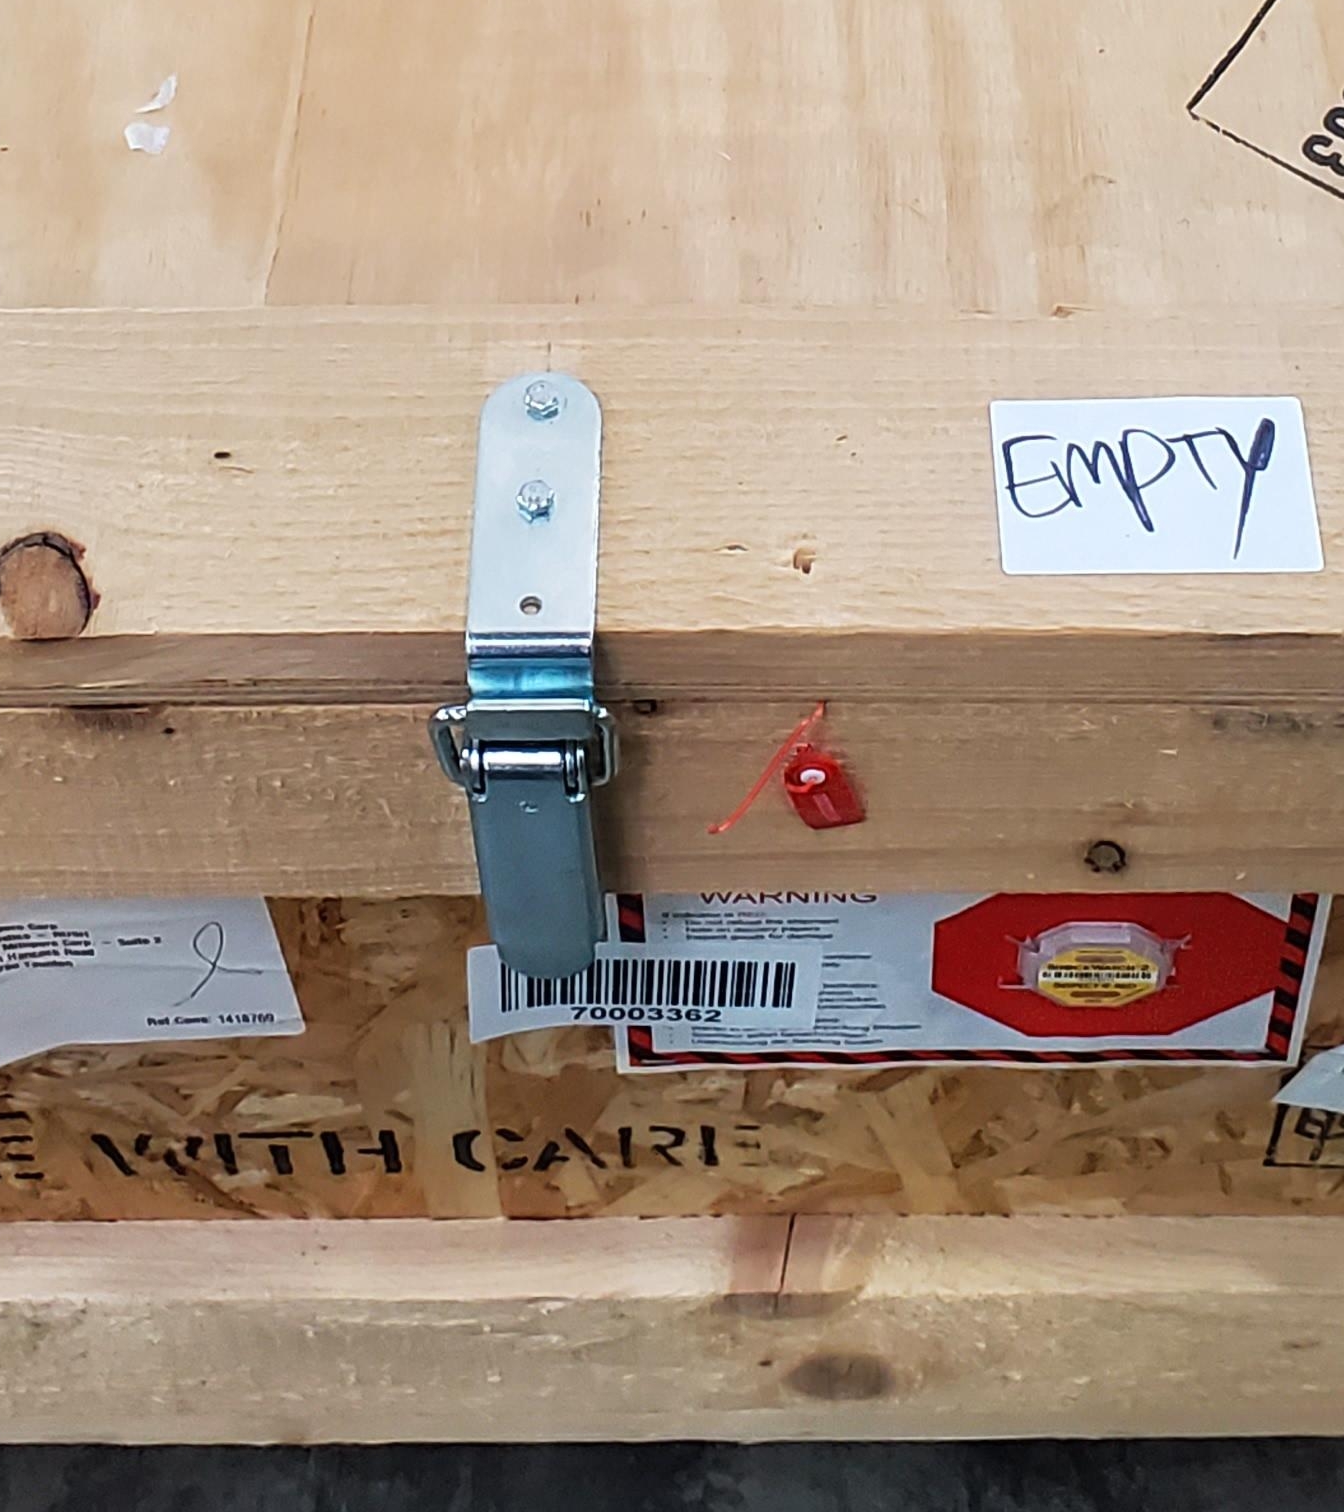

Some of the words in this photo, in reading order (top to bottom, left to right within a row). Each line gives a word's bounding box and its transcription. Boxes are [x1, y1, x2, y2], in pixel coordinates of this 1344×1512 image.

[1001, 417, 1276, 561] EMPTY
[700, 890, 879, 905] WARNING
[570, 1006, 722, 1023] 70003362
[91, 1128, 403, 1176] WITH
[452, 1124, 763, 1174] CARE
